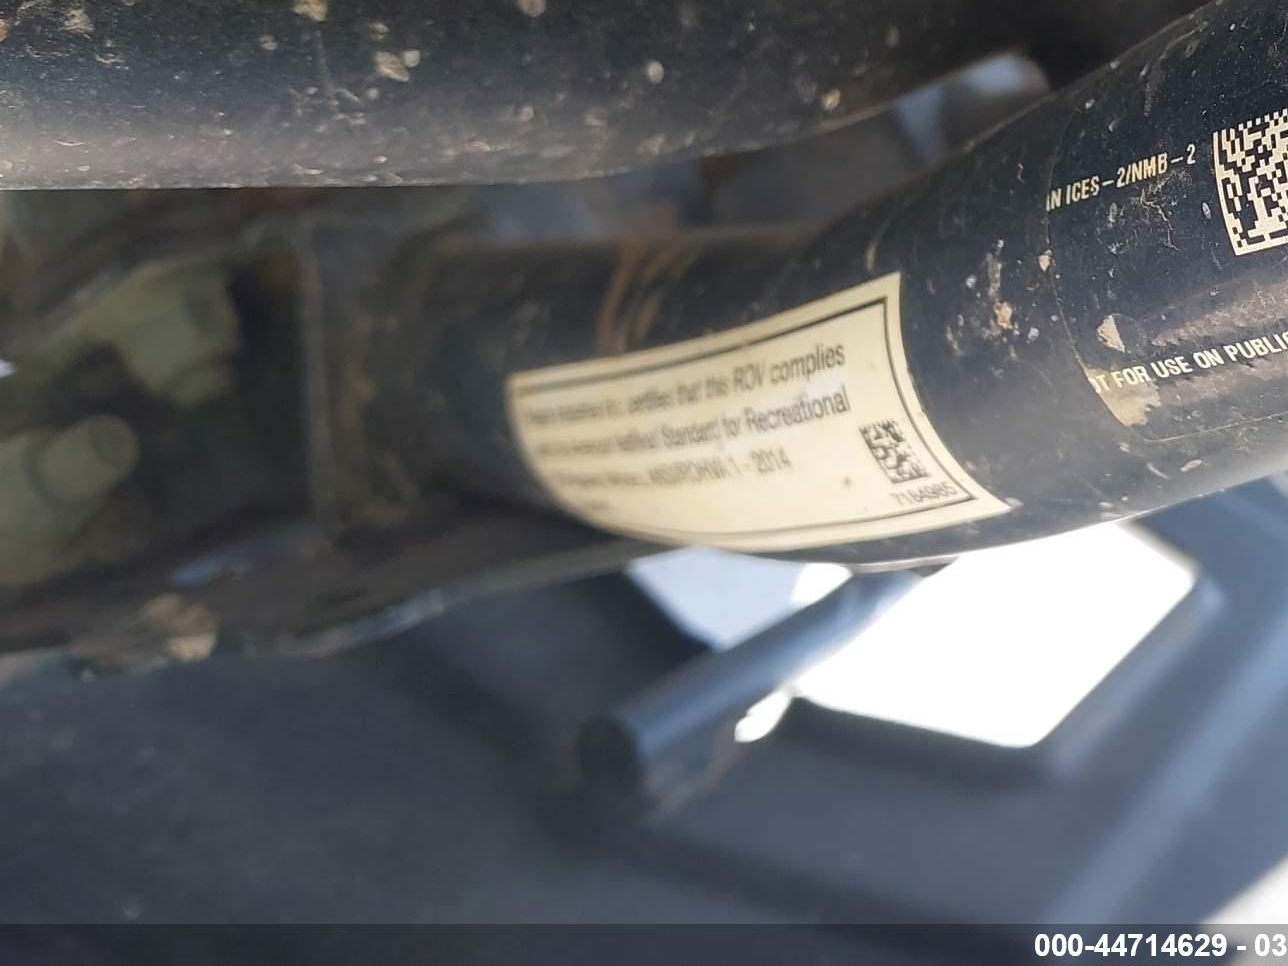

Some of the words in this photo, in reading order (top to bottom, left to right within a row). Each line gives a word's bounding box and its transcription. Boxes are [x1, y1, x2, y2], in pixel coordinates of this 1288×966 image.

[769, 342, 846, 385] complies
[1111, 364, 1152, 390] FOR
[1152, 355, 1193, 379] USE
[1196, 348, 1225, 369] ON
[745, 385, 852, 430] Recreational
[751, 447, 793, 474] 2014
